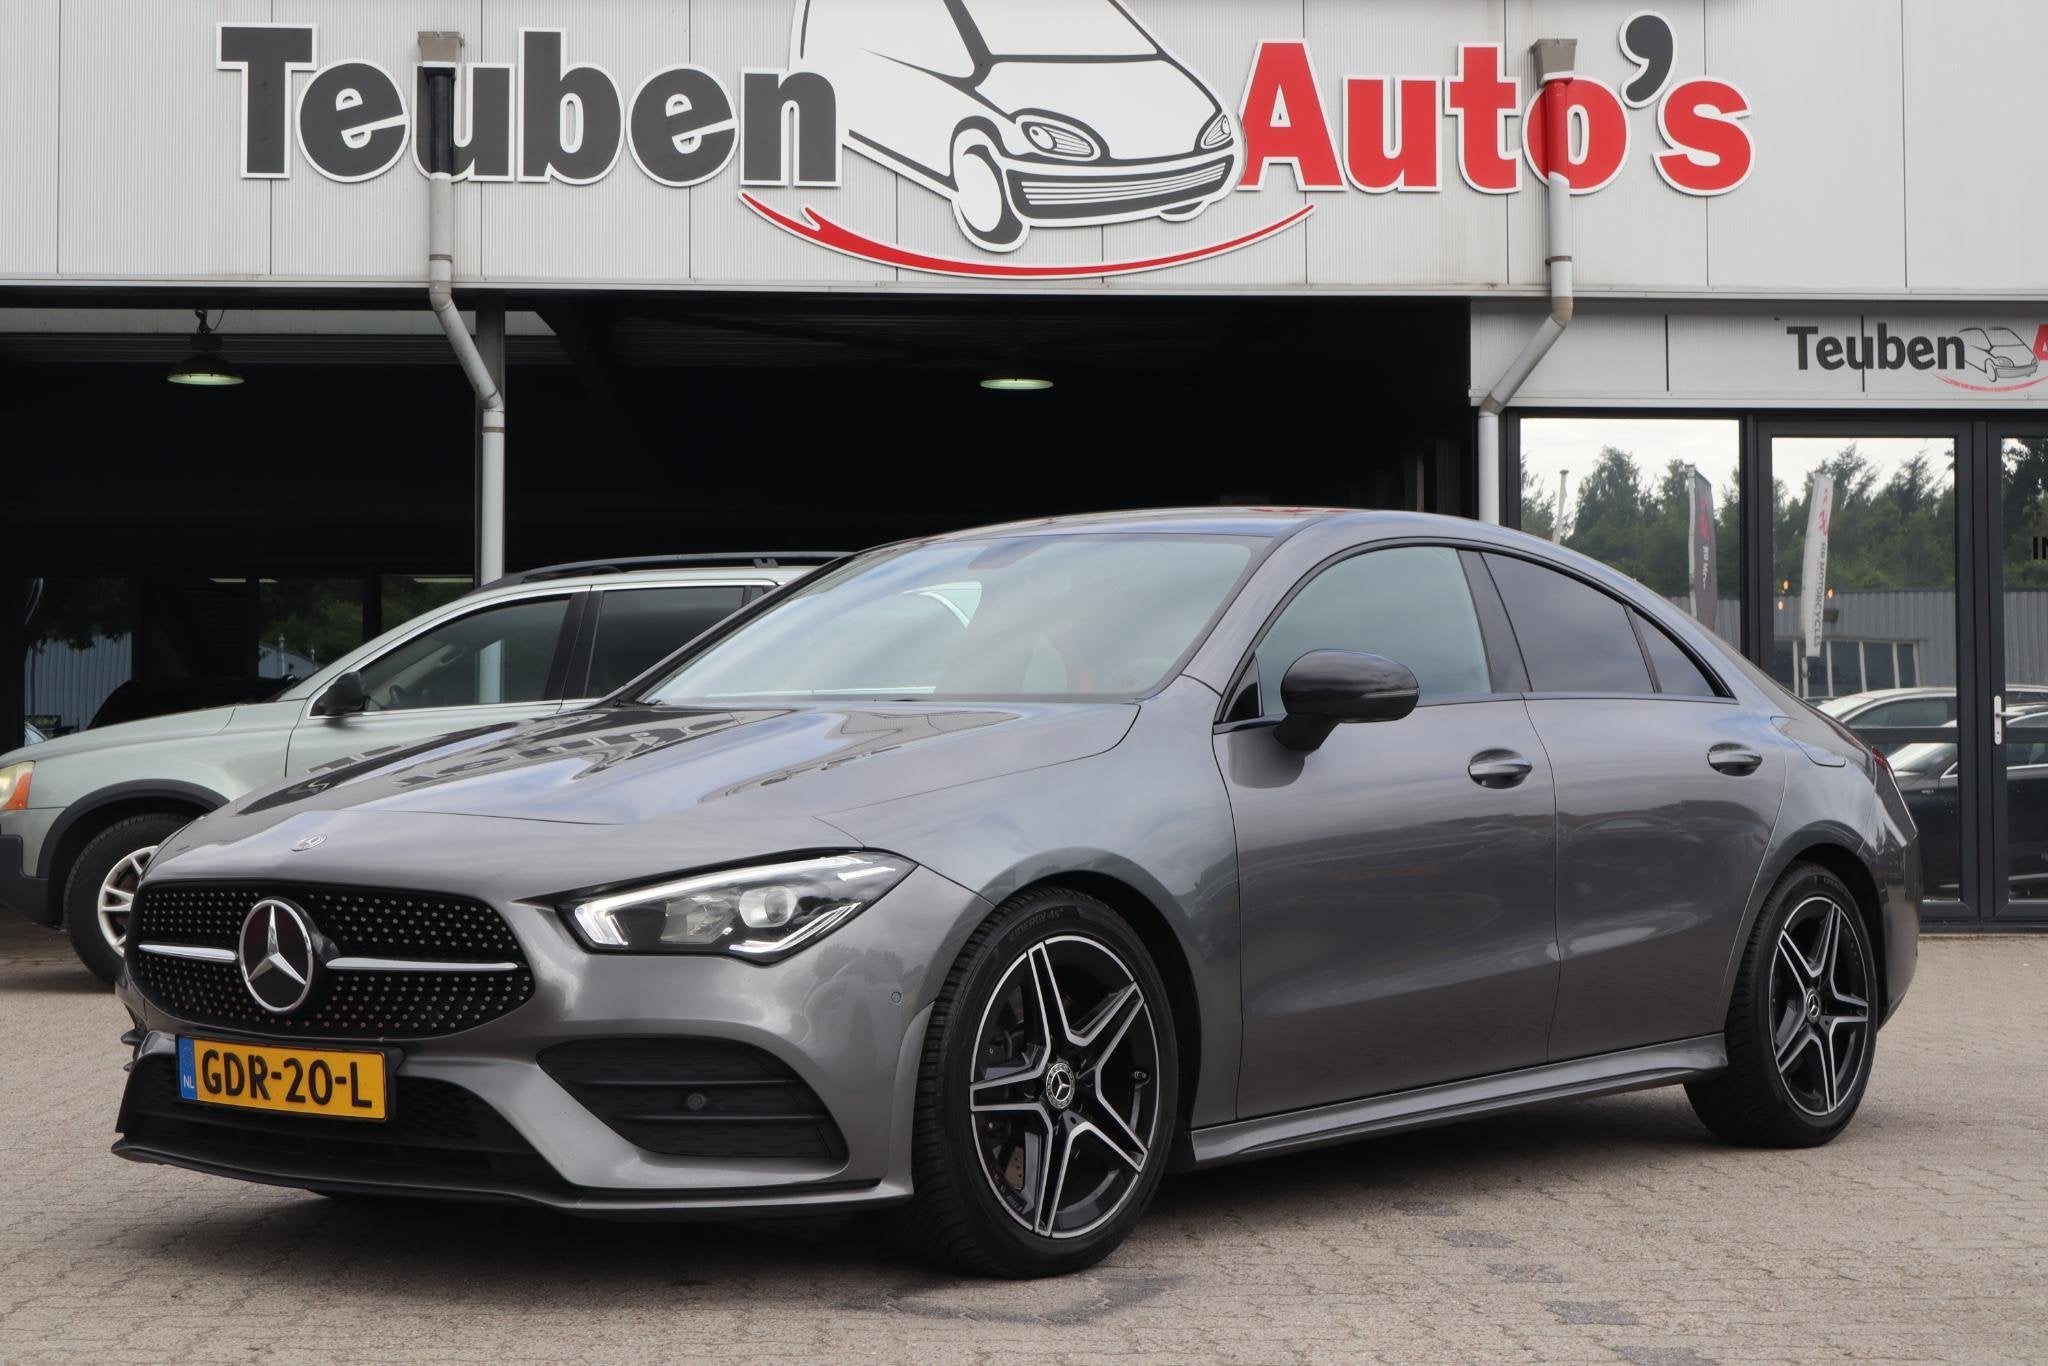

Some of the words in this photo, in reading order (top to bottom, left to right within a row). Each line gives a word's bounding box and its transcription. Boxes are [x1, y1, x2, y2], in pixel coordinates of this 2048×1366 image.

[218, 25, 840, 185] Teuben
[1239, 12, 1754, 194] Auto's
[1786, 321, 1965, 371] Teuben
[1814, 561, 1825, 648] MOTORCYCLES
[183, 1074, 195, 1089] NL
[202, 1049, 373, 1109] GDR-20-L
